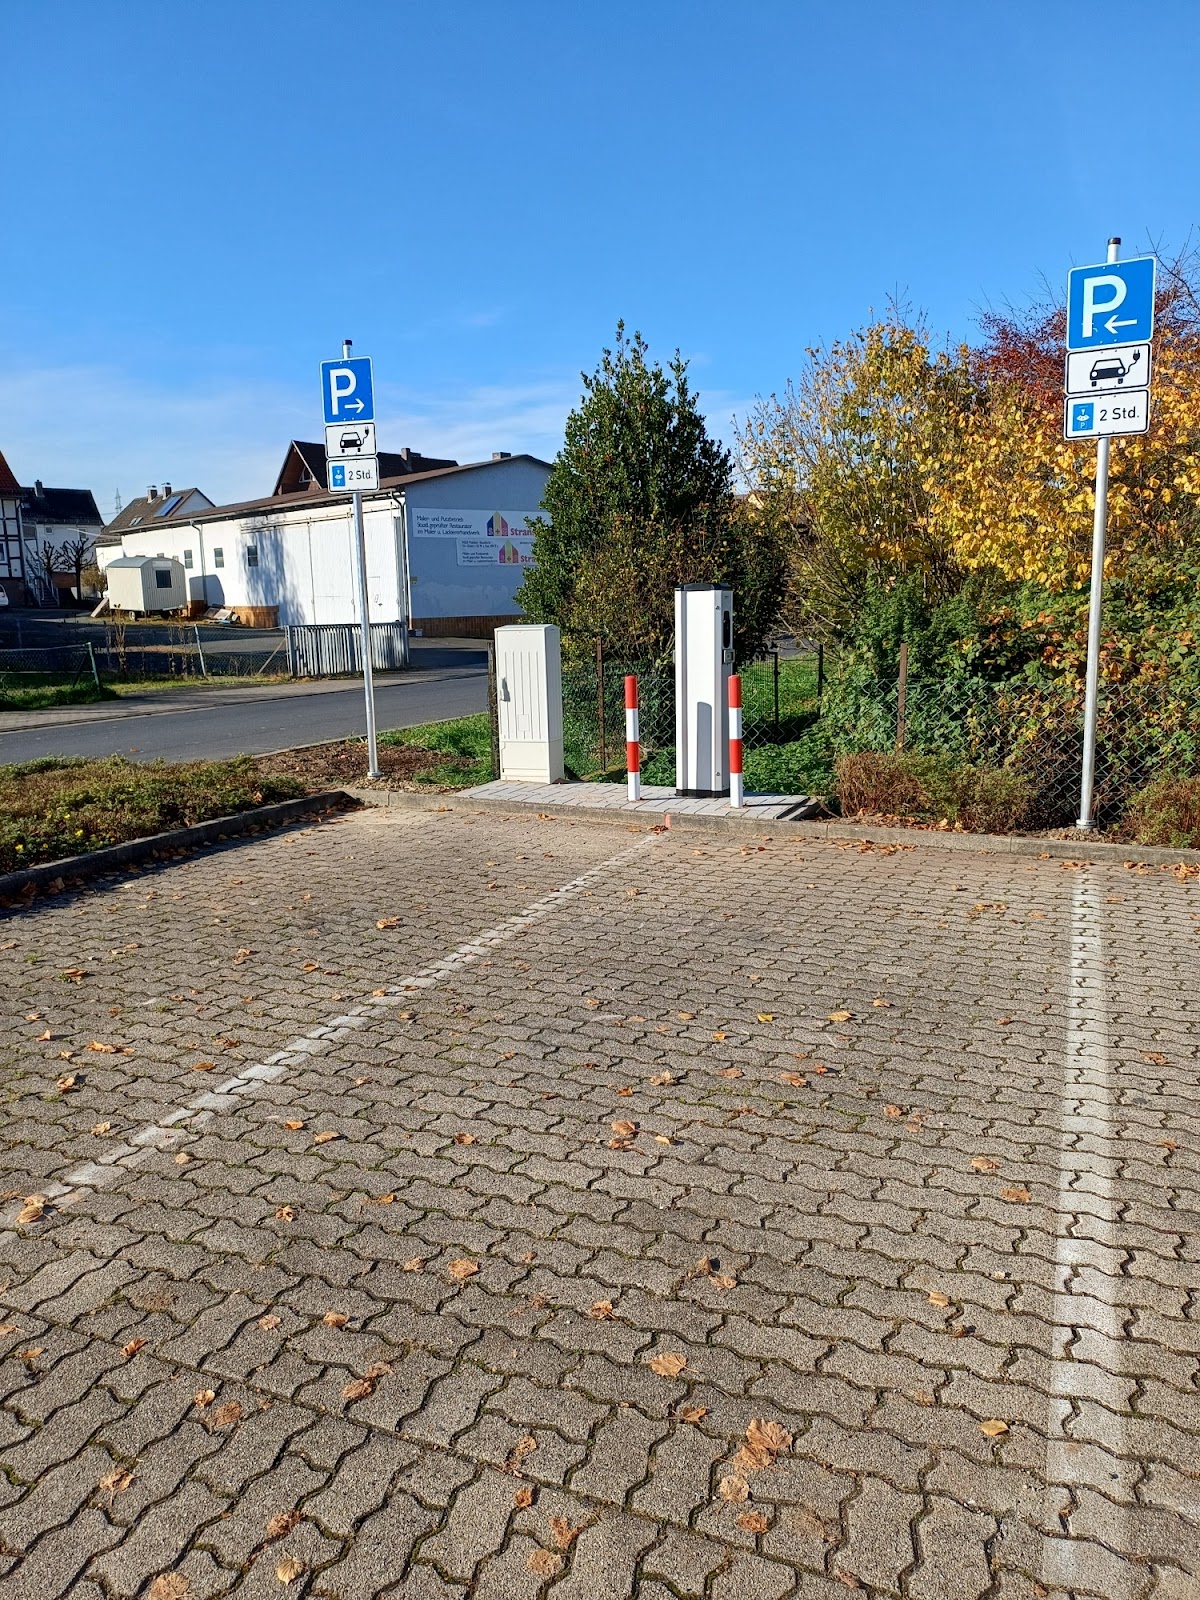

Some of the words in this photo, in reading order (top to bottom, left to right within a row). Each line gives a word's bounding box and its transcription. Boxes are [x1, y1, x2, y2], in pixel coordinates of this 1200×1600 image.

[1082, 275, 1128, 339] P
[329, 368, 357, 415] P
[1099, 409, 1107, 421] 2
[1112, 406, 1140, 420] Std.
[348, 470, 354, 480] 2
[356, 469, 373, 480] Std.
[510, 527, 534, 536] Stran
